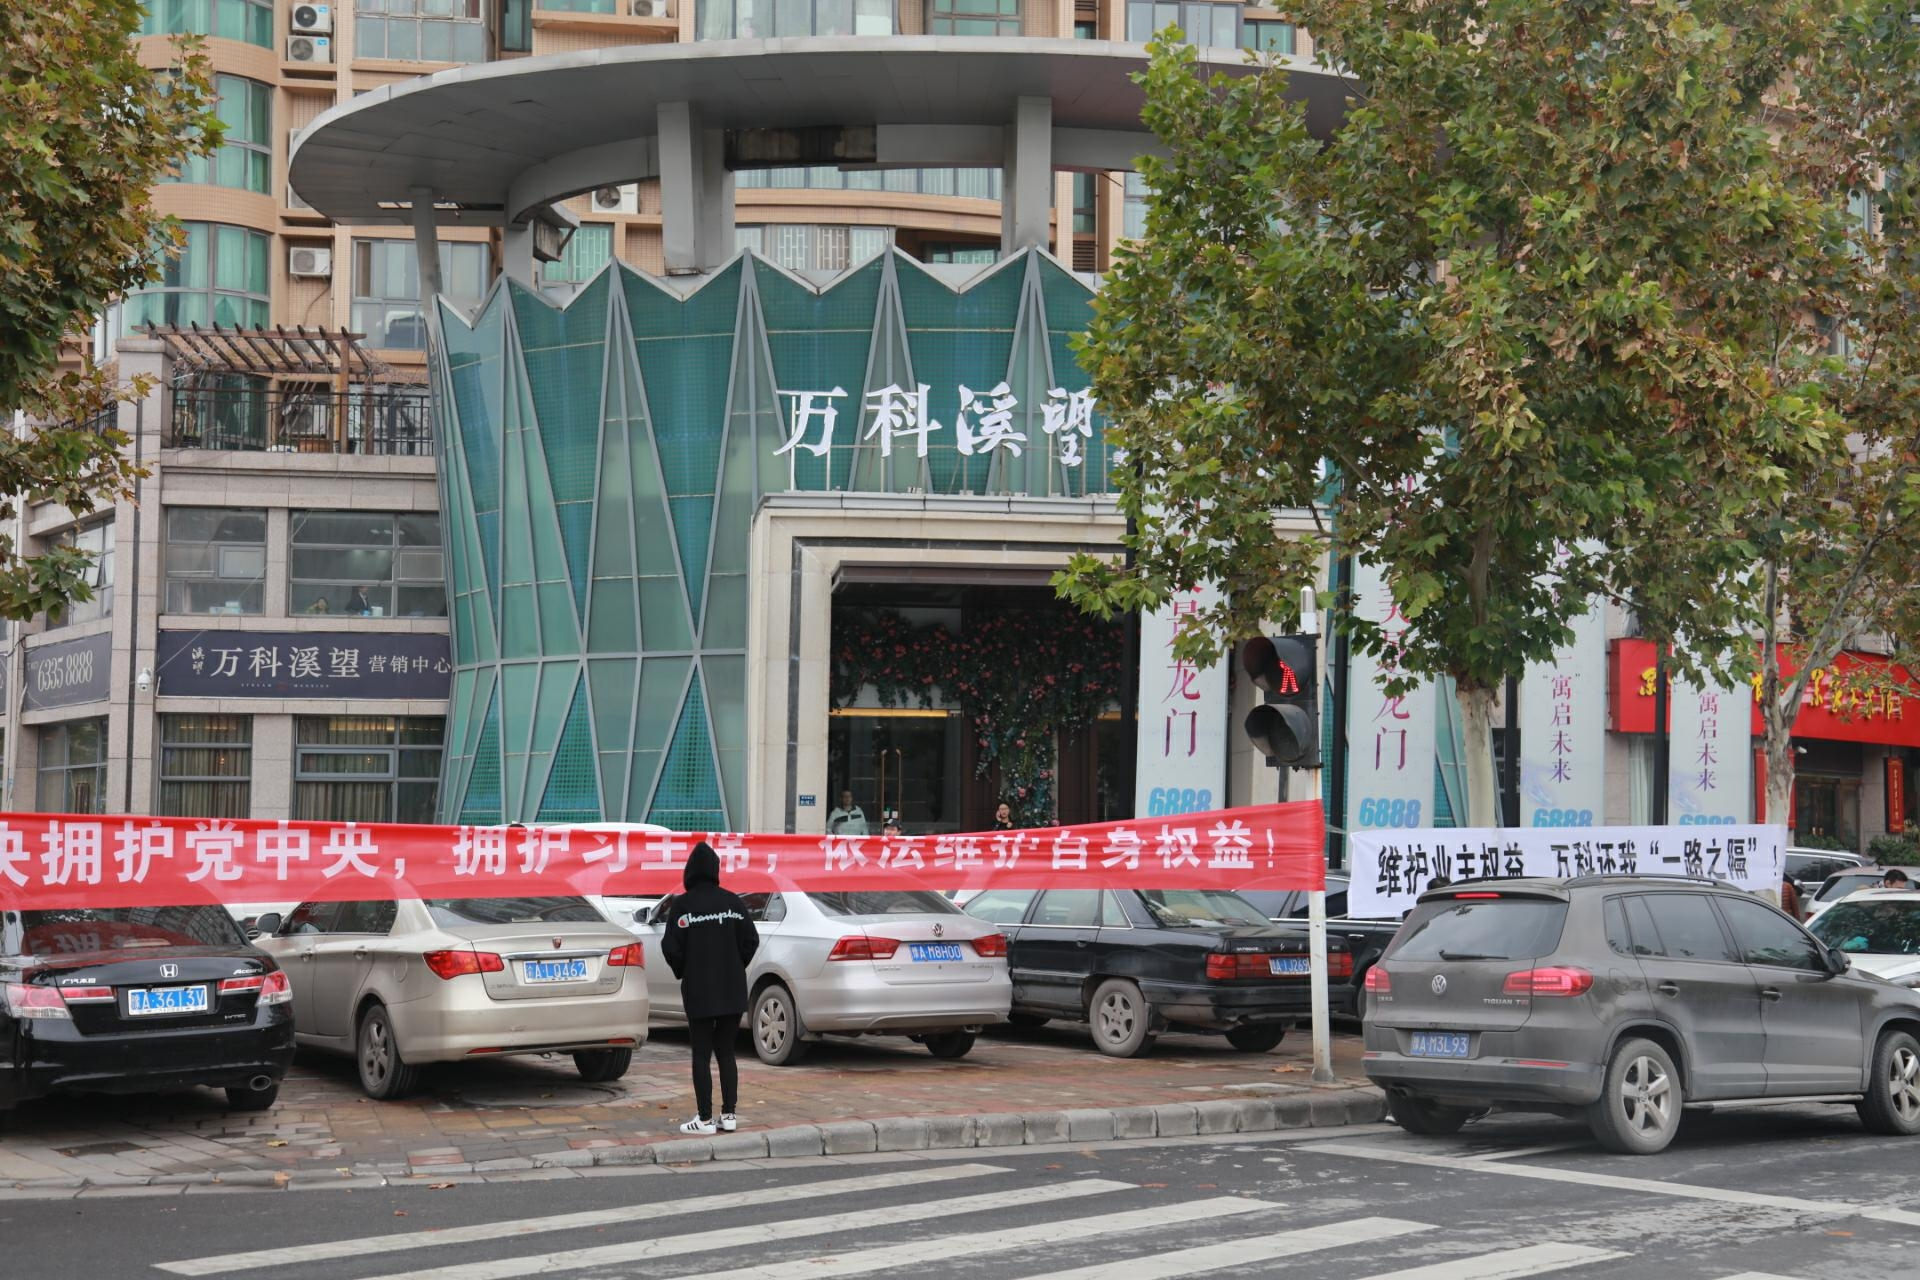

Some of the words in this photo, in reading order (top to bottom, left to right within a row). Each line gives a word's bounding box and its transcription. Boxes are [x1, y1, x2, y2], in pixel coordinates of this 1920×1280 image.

[773, 381, 1098, 467] 万科溪望
[38, 656, 64, 692] 6335
[66, 649, 93, 686] 8888
[210, 646, 360, 678] 万科溪望
[369, 655, 450, 675] 营销中心
[1148, 787, 1212, 817] 6888
[1359, 797, 1421, 827] 6888
